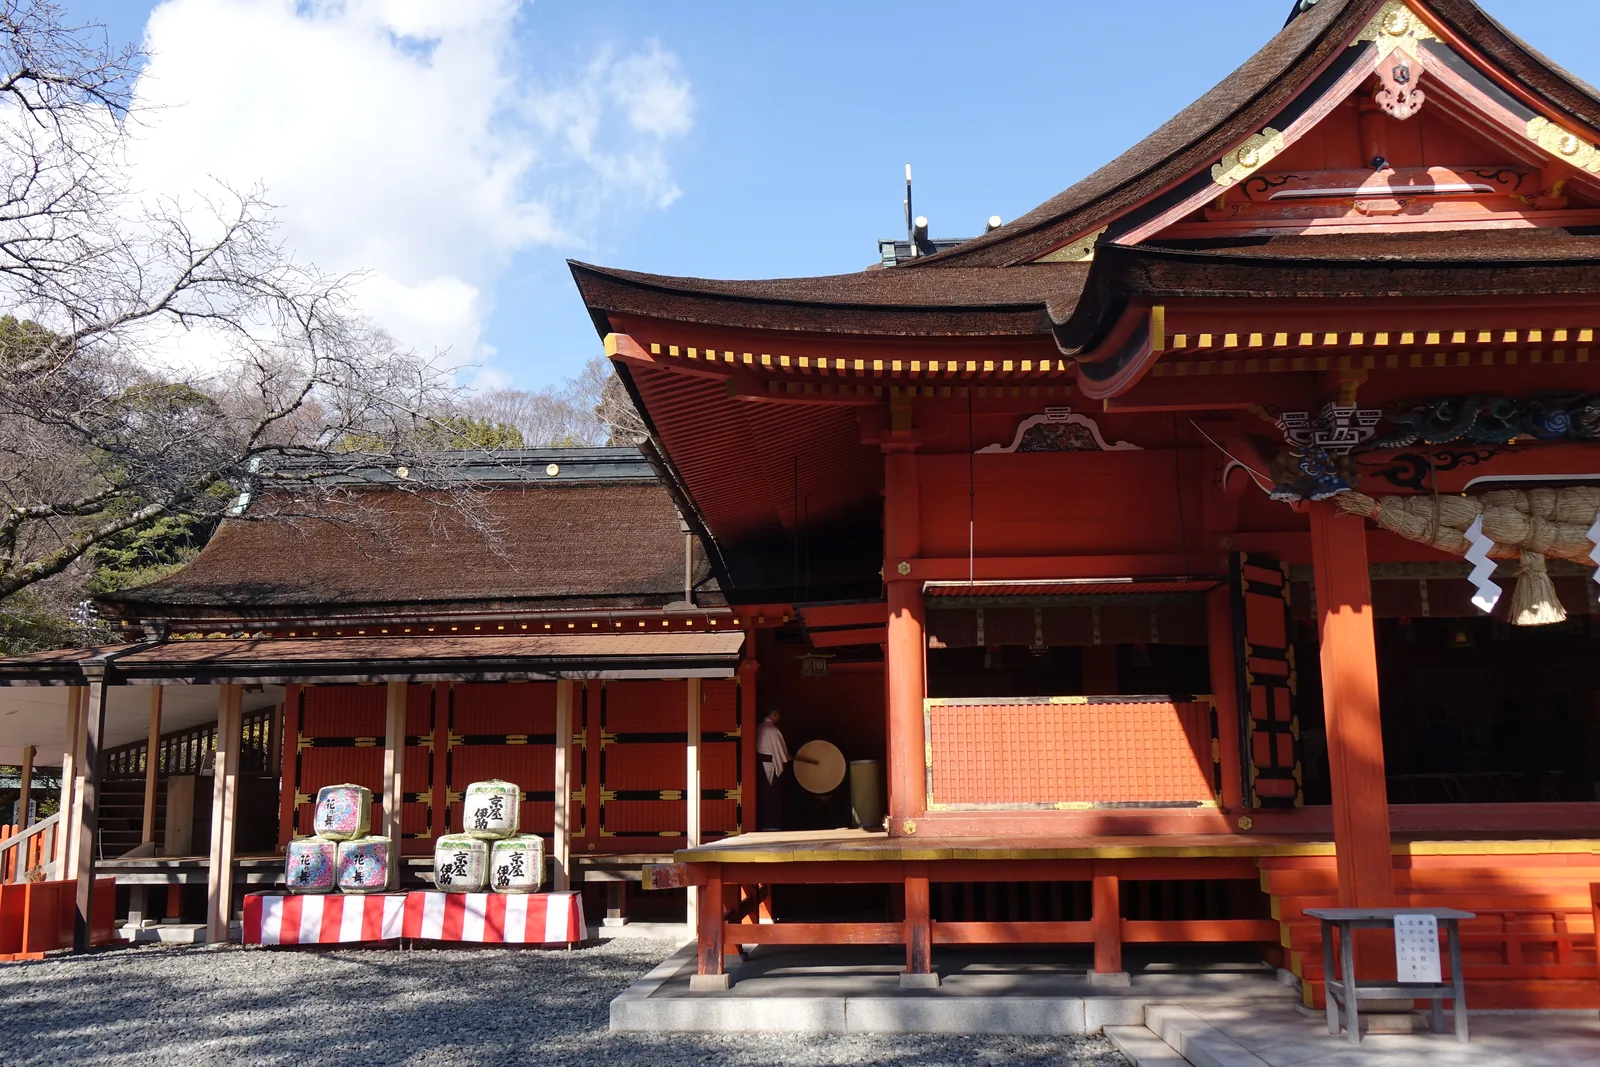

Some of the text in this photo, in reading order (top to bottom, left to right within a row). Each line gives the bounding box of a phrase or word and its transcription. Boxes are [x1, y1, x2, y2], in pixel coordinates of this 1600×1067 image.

[324, 799, 335, 828] 花の舞
[474, 808, 489, 829] 伊助
[298, 854, 311, 883] 花の舞
[352, 854, 365, 883] 花の舞
[439, 863, 453, 885] 伊助
[497, 865, 511, 886] 伊助
[1399, 920, 1407, 961] して下さい
